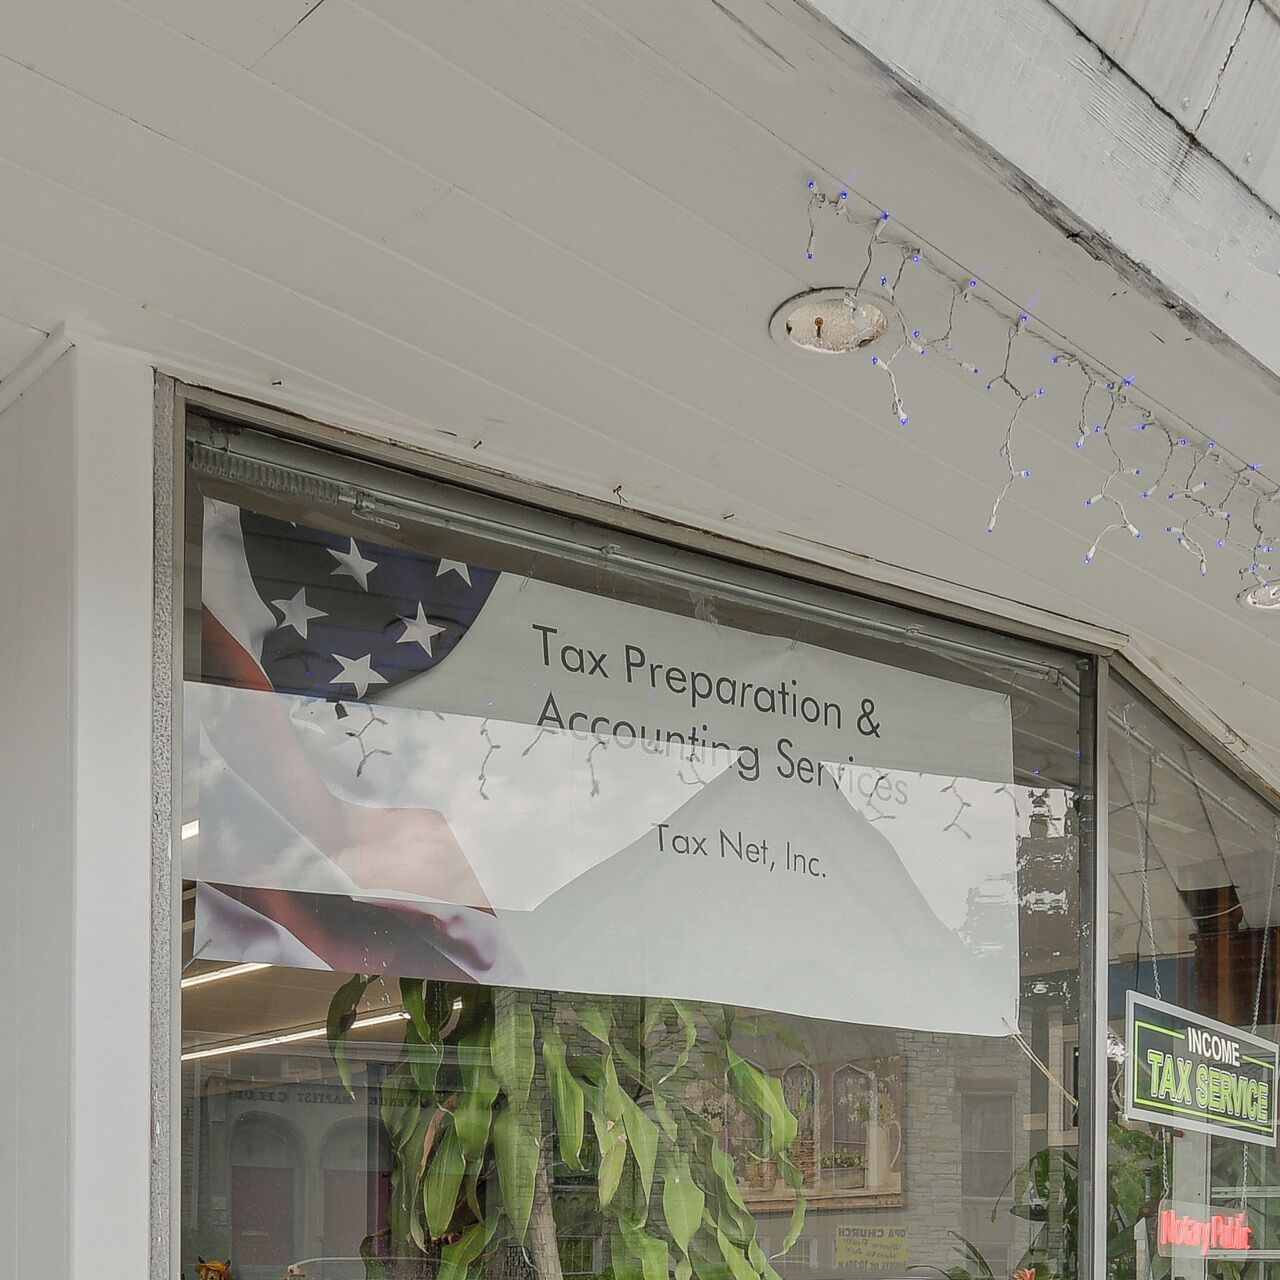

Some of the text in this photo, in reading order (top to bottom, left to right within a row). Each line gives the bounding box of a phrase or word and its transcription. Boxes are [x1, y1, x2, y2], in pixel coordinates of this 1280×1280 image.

[532, 623, 882, 739] Tax Preparation &
[536, 691, 910, 807] Accounting Services
[653, 822, 827, 878] Tax Net, Inc.
[1187, 1026, 1241, 1068] INCOME
[1147, 1049, 1269, 1123] TAX SERVICE
